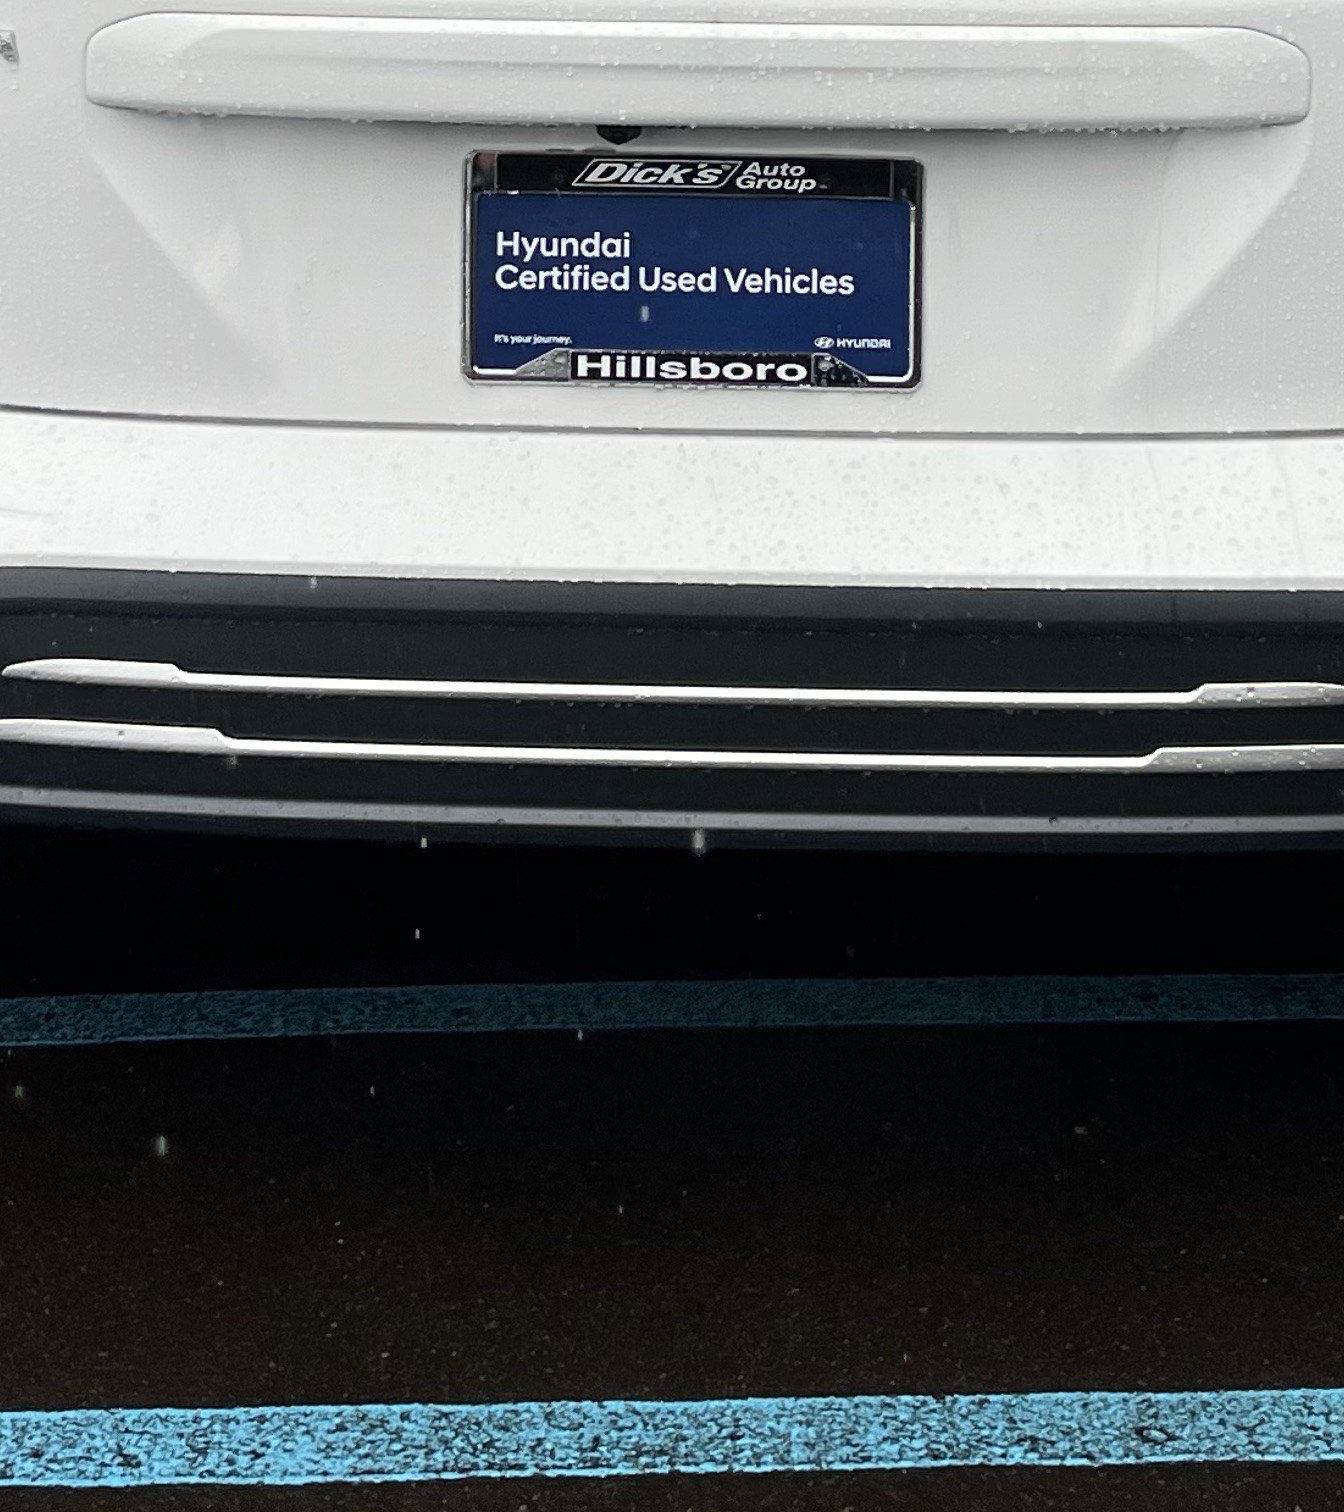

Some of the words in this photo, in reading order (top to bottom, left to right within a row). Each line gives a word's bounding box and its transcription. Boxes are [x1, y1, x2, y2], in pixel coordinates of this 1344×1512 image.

[584, 161, 723, 185] Dick's
[741, 161, 806, 177] Auto
[735, 175, 817, 194] Group
[495, 230, 631, 263] Hyundai
[494, 264, 631, 291] Certified
[638, 265, 718, 293] Used
[723, 266, 855, 295] Vehicles
[494, 333, 509, 344] It's
[510, 335, 532, 345] your
[836, 337, 892, 349] HYUNDAI
[576, 354, 808, 382] Hillsboro
